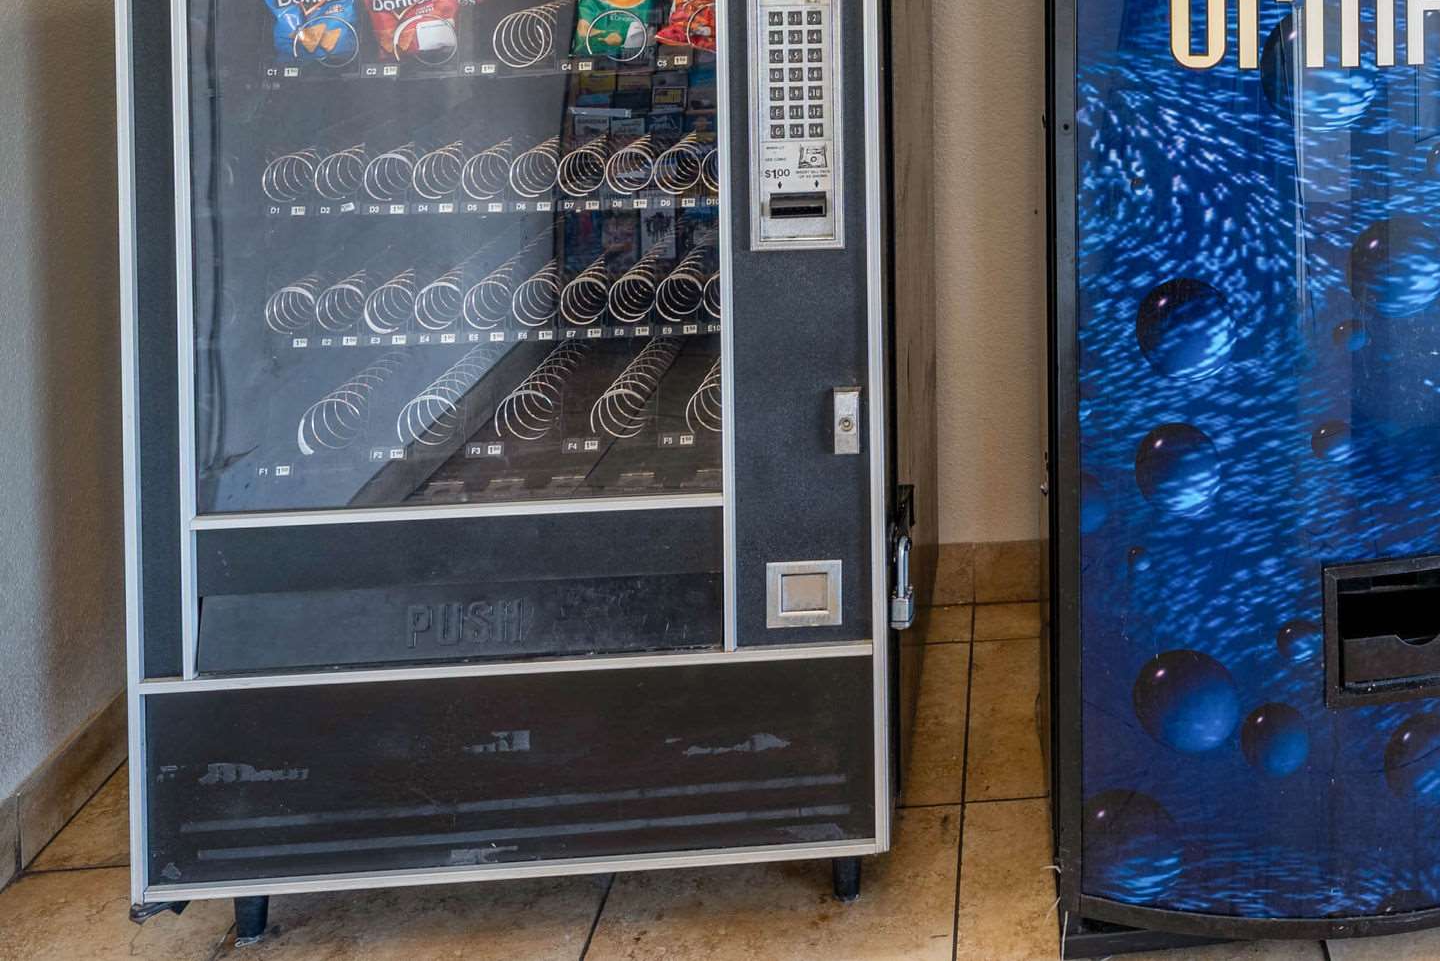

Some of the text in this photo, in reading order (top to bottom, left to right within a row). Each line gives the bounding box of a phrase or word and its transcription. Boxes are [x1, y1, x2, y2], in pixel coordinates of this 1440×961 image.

[657, 60, 667, 68] C5
[267, 68, 277, 76] C1
[764, 168, 790, 179] $1.00
[407, 596, 533, 649] PUSH
